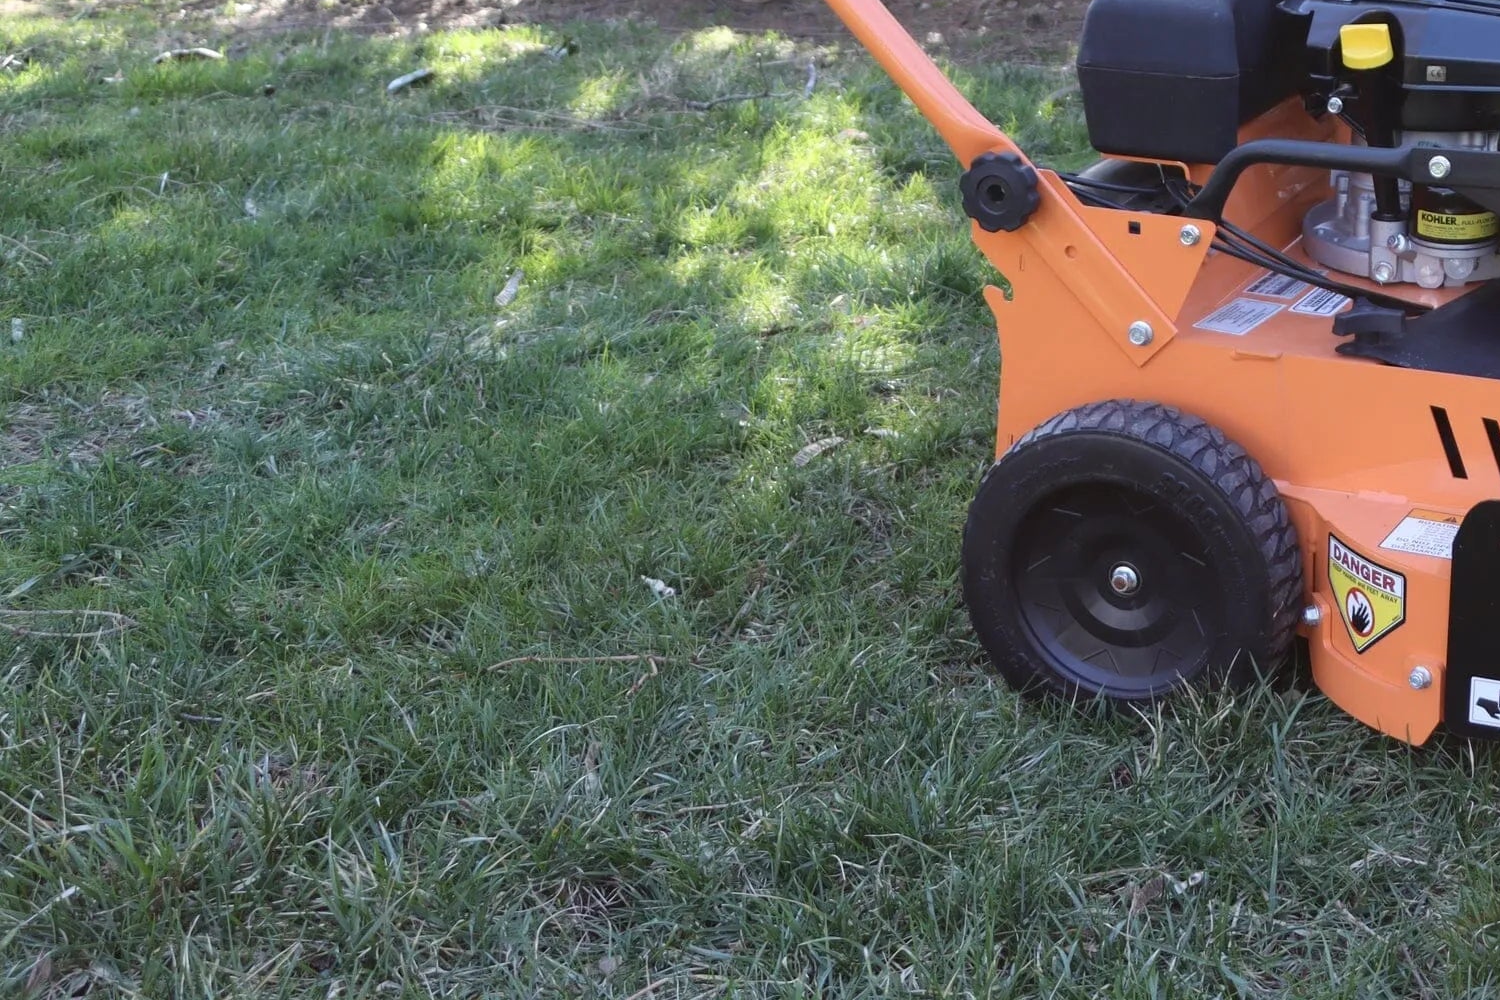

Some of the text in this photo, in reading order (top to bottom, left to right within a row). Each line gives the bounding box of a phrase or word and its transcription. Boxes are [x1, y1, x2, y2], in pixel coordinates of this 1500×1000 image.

[1421, 212, 1457, 226] KOHLER
[1332, 543, 1397, 593] DANGER
[1366, 585, 1380, 597] FEET
[1380, 592, 1399, 604] AWAY
